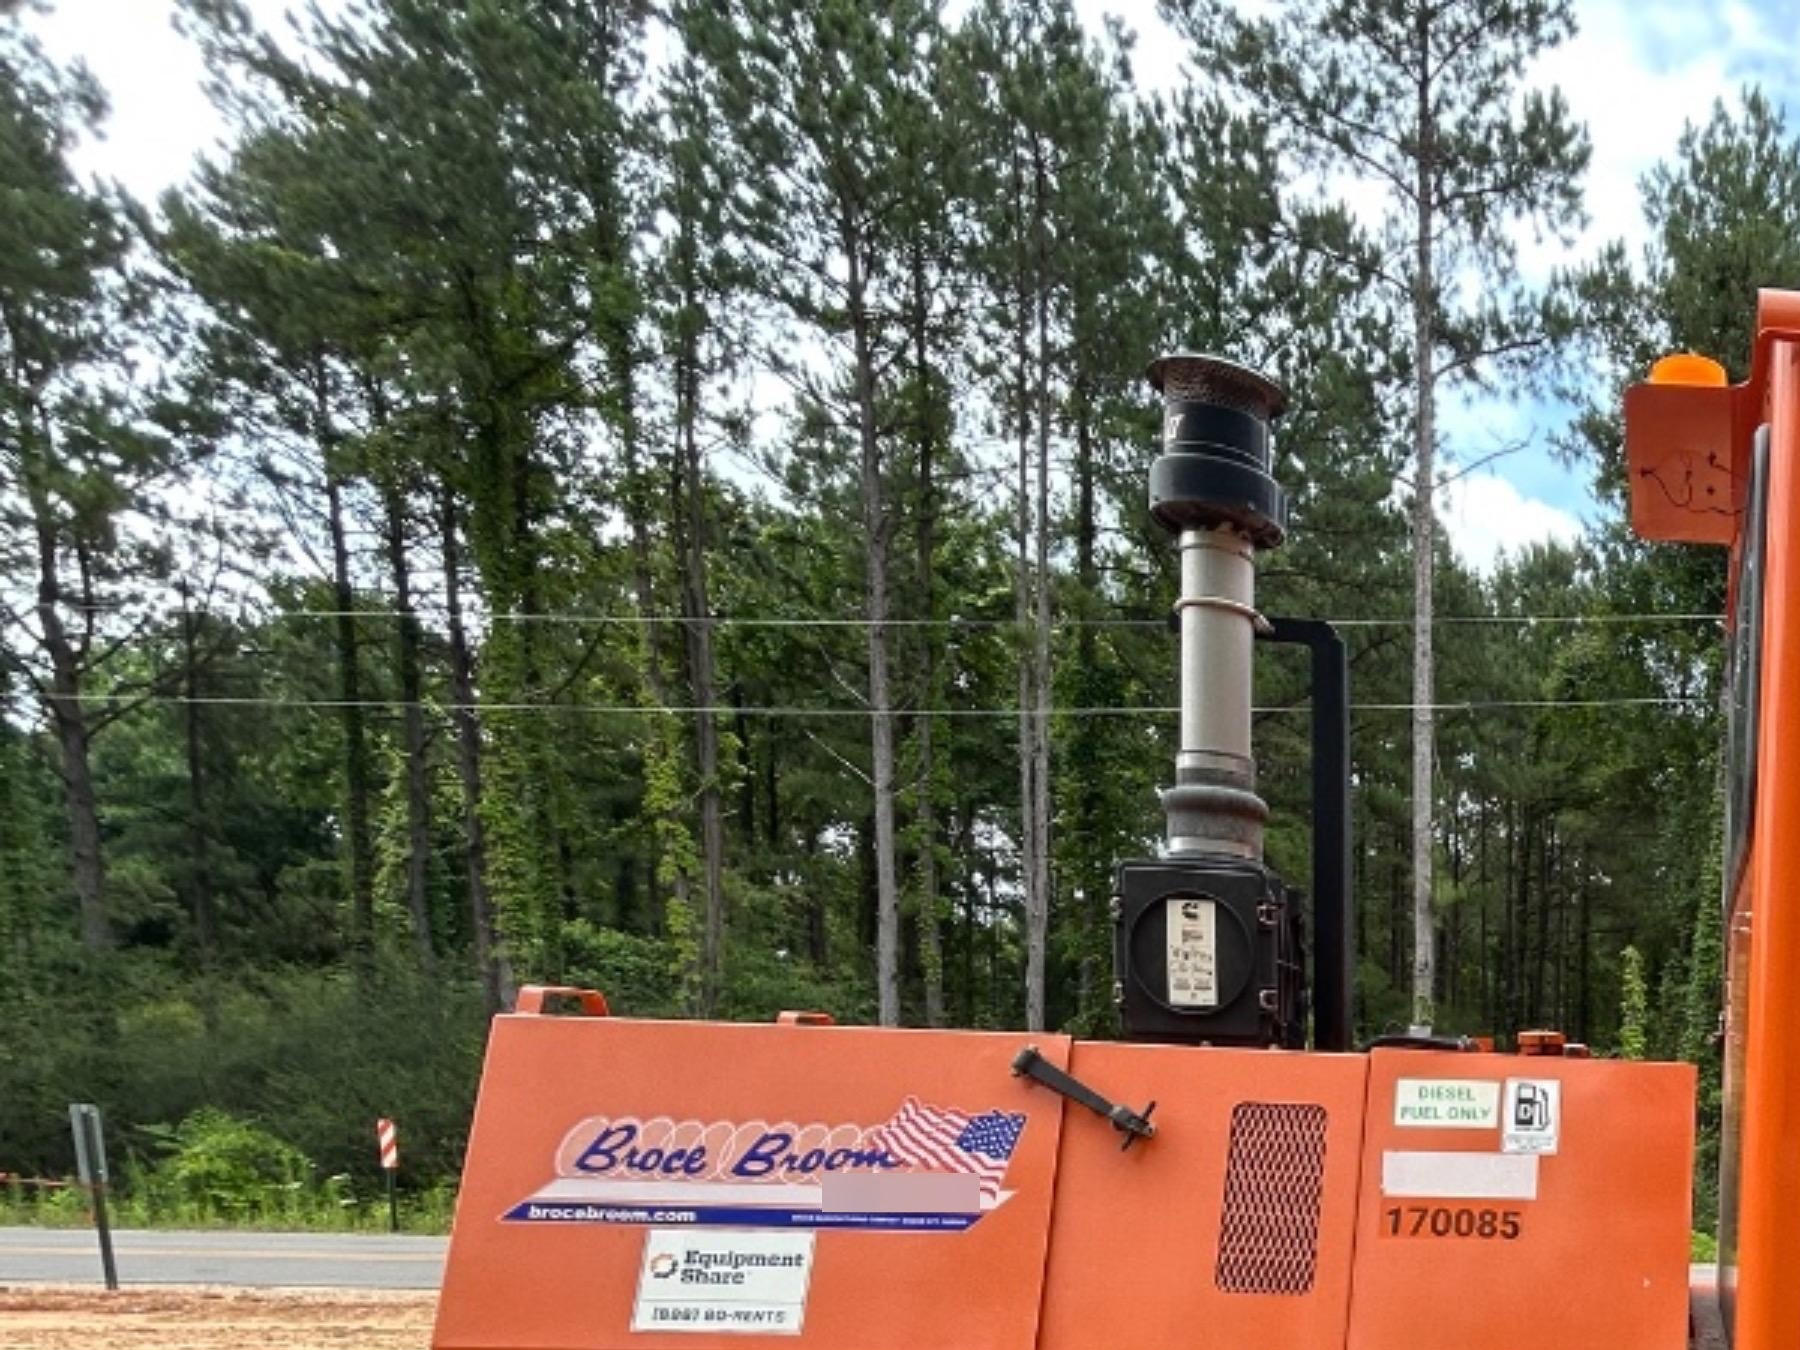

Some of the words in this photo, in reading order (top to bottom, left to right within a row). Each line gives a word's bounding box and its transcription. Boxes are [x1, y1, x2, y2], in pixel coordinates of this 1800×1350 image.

[1418, 1085, 1476, 1101] DIESEL
[1400, 1106, 1442, 1119] FUEL
[1447, 1106, 1491, 1120] ONLY
[575, 1124, 707, 1174] Broce
[731, 1132, 905, 1177] Broom
[1386, 1207, 1522, 1240] 170085
[683, 1250, 805, 1270] Equipment
[679, 1268, 745, 1285] Share
